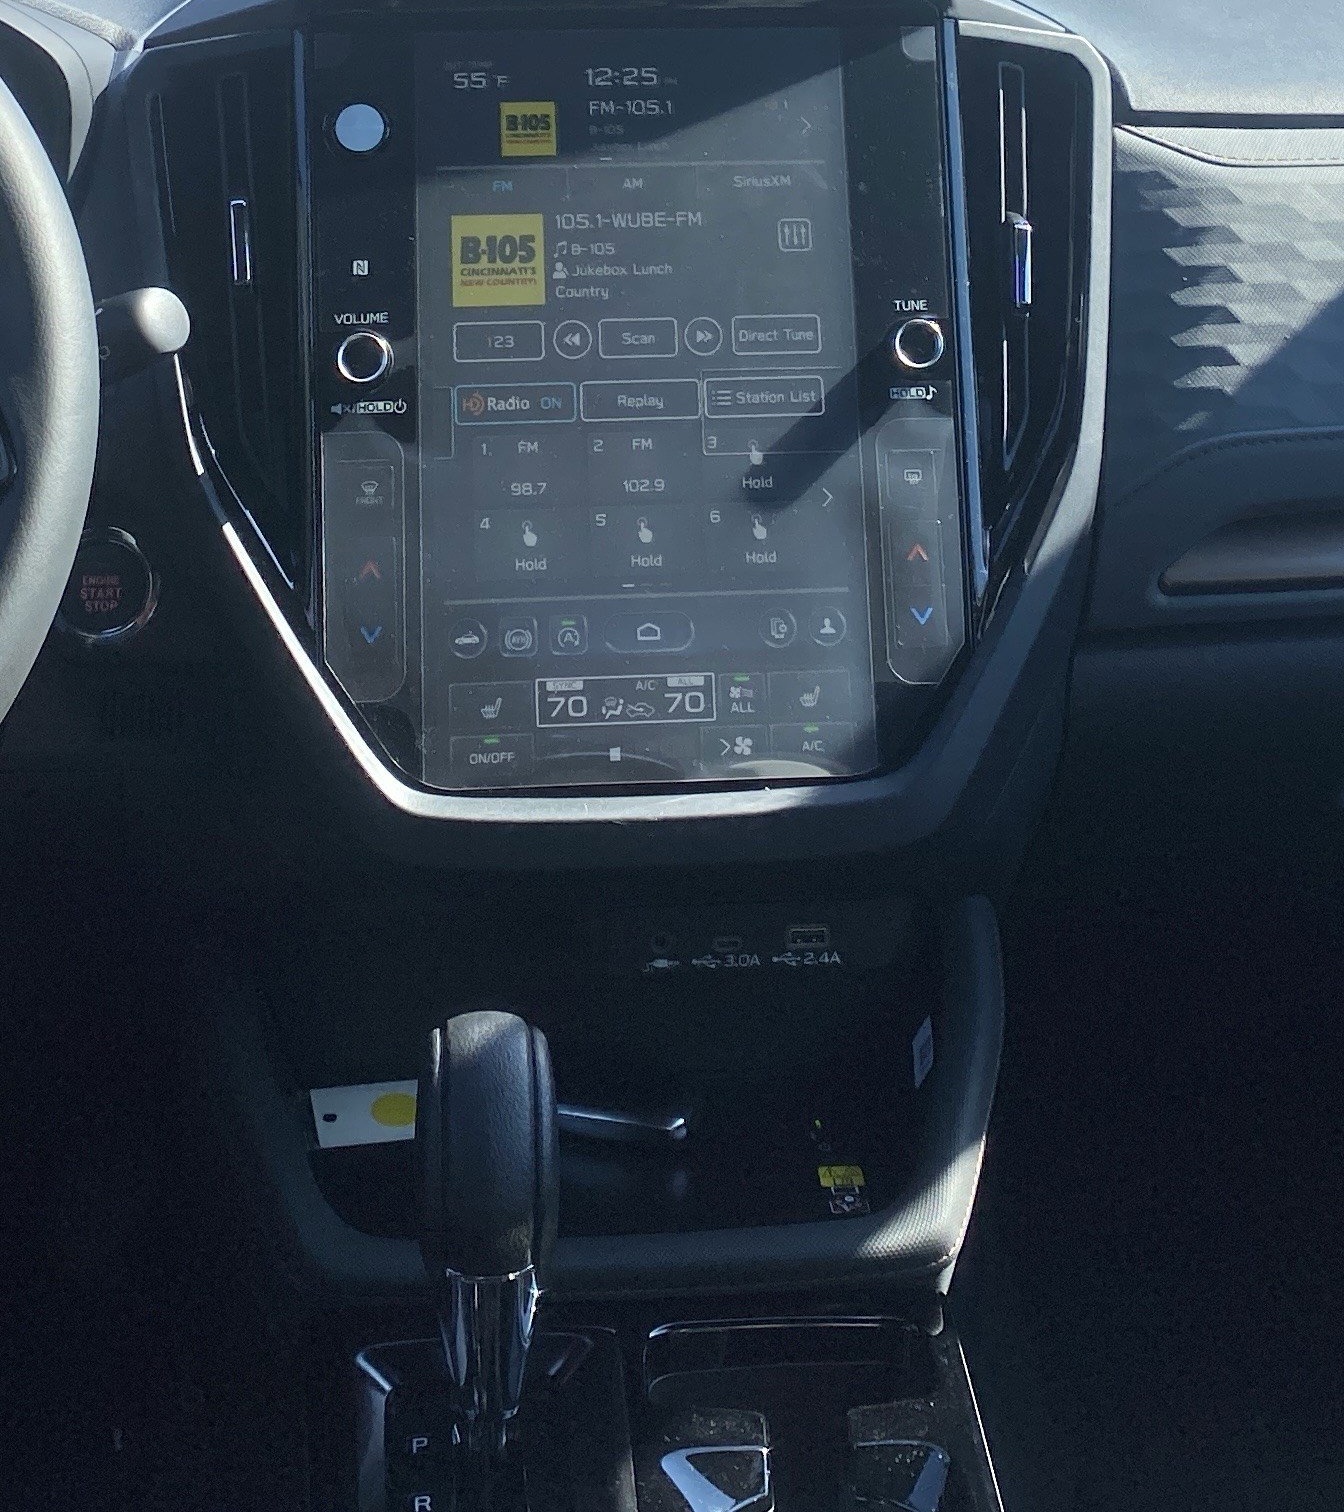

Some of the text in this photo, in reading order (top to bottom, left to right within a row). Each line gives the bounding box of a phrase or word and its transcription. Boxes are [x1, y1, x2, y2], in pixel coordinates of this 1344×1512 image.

[585, 67, 657, 87] 12:25
[589, 99, 673, 116] FM-105.1
[492, 180, 513, 193] FM
[622, 177, 644, 190] AM
[733, 175, 792, 189] SiriusXM
[556, 212, 702, 230] 105.1-WUBE-FM
[571, 242, 616, 257] B-105
[572, 262, 674, 278] Jukebox Lunch
[556, 285, 610, 301] Country
[893, 299, 928, 312] TUNE
[334, 312, 389, 326] VOLUME
[621, 332, 656, 345] Scan
[737, 327, 814, 342] Direct Tune
[616, 393, 664, 409] Replay
[735, 388, 817, 404] Station List
[891, 388, 926, 399] HOLD
[357, 403, 393, 414] HOLD
[486, 395, 531, 411] Radio
[517, 442, 539, 454] FM
[593, 439, 604, 452] 2
[632, 437, 653, 450] FM
[707, 436, 717, 449] 3
[510, 482, 547, 497] 98.7
[622, 478, 665, 493] 102.9
[742, 475, 774, 489] Hold
[480, 516, 490, 530] 4
[595, 513, 606, 527] 5
[709, 510, 720, 524] 6
[515, 556, 547, 571] Hold
[630, 553, 662, 568] Hold
[745, 550, 777, 565] Hold
[636, 678, 656, 691] A/C
[547, 695, 588, 717] 70
[664, 691, 706, 714] 70
[730, 700, 755, 713] ALL
[801, 740, 826, 752] A/C
[468, 750, 516, 765] ON/OFF
[724, 953, 761, 968] 3.0A
[803, 951, 842, 966] 2.4A
[412, 1437, 428, 1453] P
[415, 1495, 432, 1512] R
